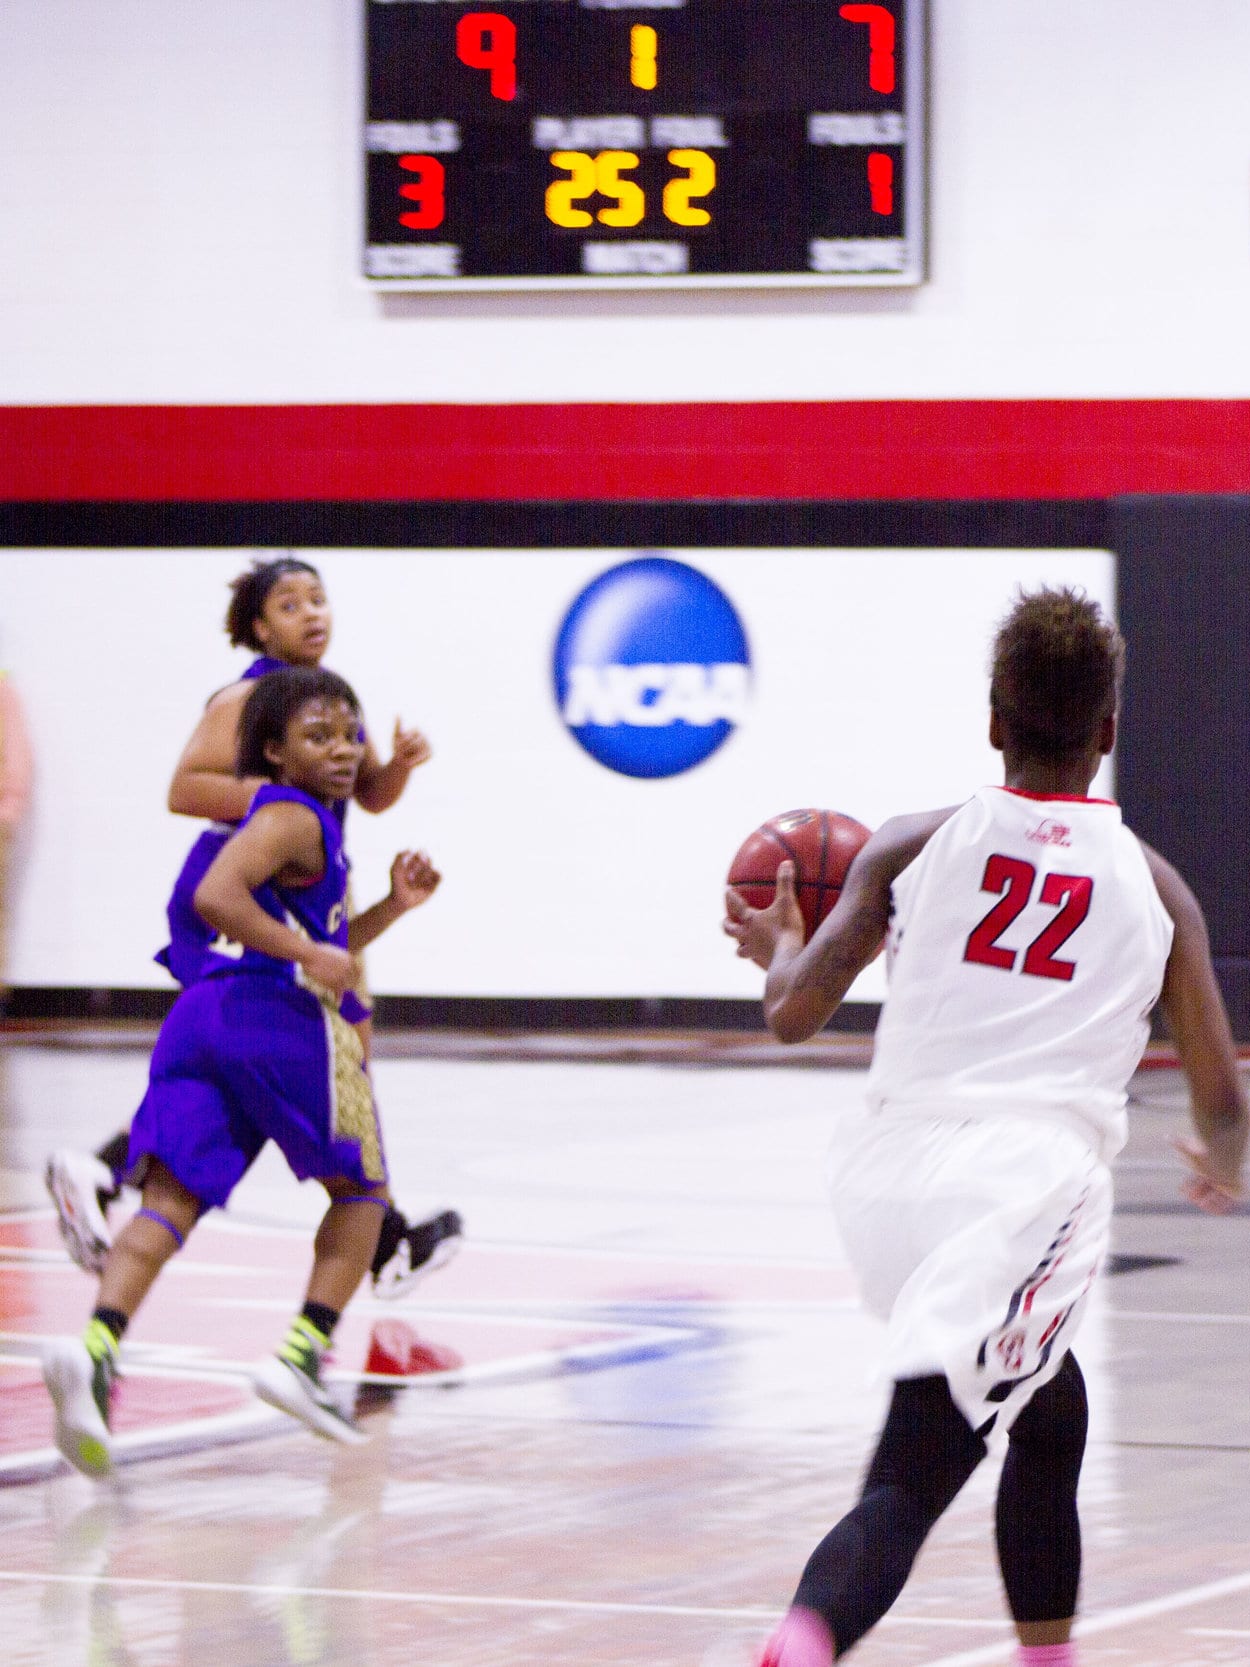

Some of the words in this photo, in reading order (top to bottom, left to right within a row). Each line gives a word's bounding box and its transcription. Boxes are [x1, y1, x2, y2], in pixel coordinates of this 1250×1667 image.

[456, 12, 516, 101] 9
[630, 24, 657, 90] 1
[840, 4, 895, 94] 7
[399, 155, 444, 229] 3
[545, 150, 645, 228] 25
[663, 149, 716, 227] 2
[867, 153, 893, 216] 1
[565, 661, 754, 727] NCAA
[964, 853, 1094, 981] 22
